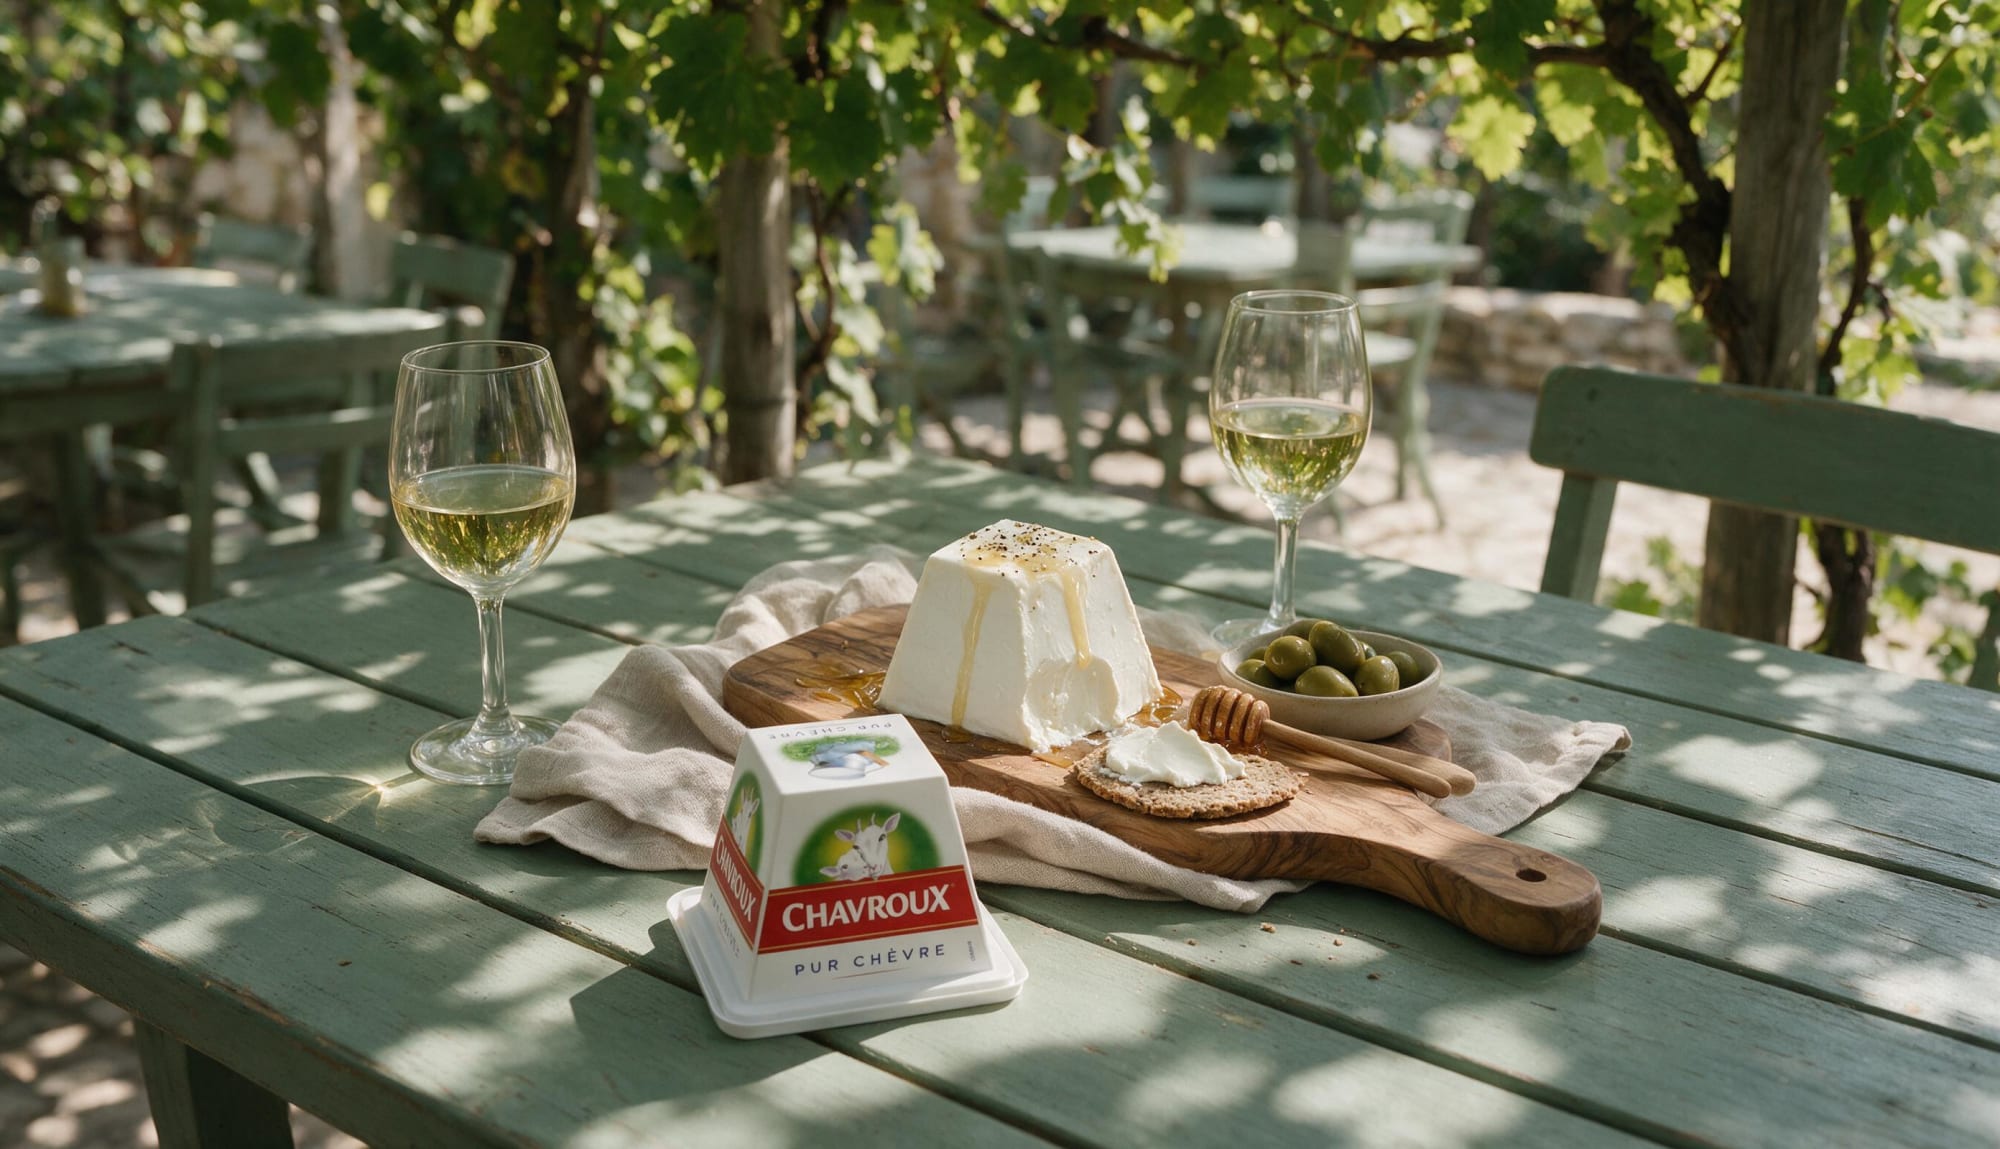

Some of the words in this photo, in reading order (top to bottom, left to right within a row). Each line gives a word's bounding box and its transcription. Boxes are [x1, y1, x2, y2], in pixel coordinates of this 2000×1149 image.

[715, 834, 757, 923] CHAVROUX
[782, 884, 950, 932] CHAVROUX
[794, 959, 839, 976] PUR
[853, 944, 945, 967] CHÈVRE
